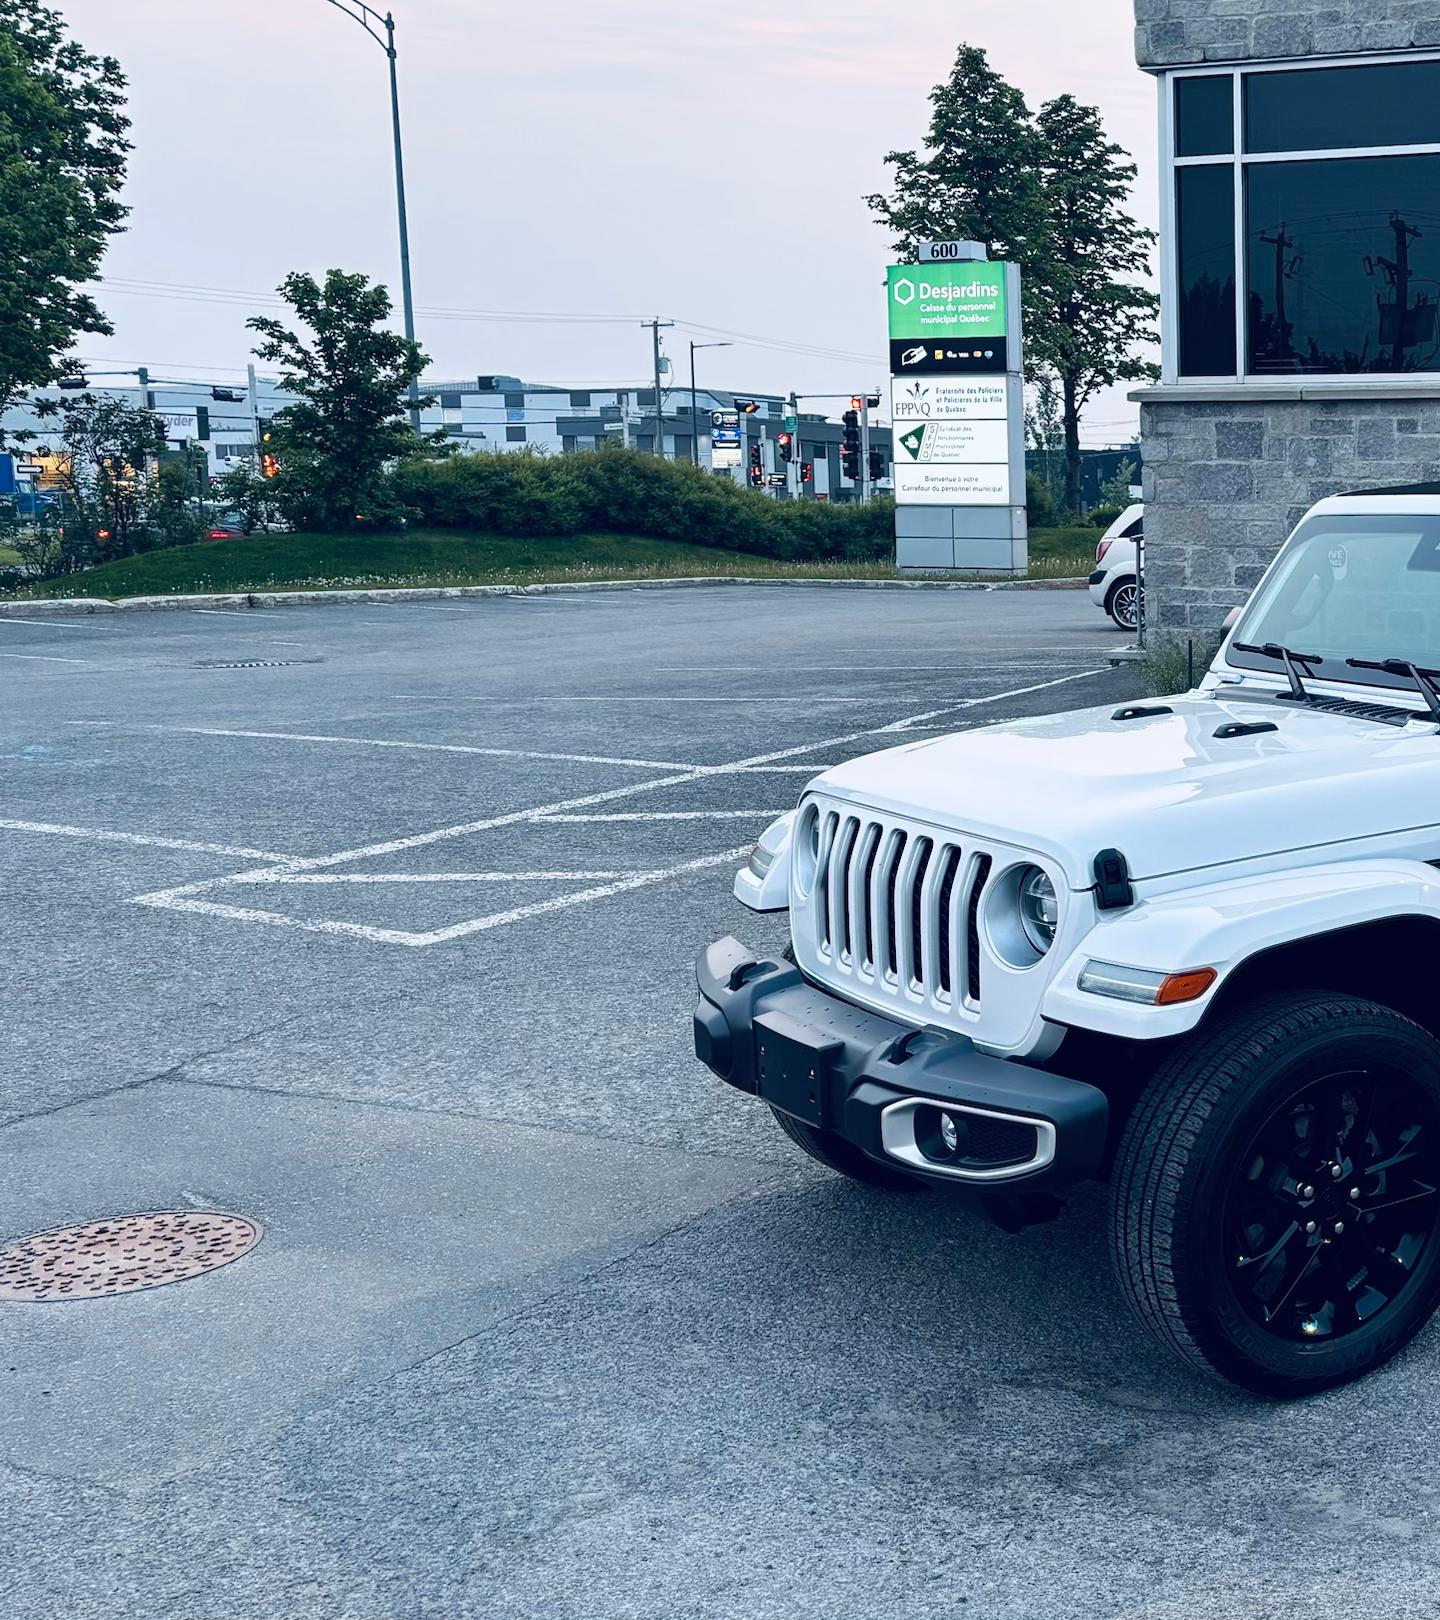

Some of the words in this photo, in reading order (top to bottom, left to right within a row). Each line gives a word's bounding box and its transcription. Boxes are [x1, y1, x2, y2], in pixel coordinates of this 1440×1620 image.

[931, 243, 958, 258] 600
[919, 281, 998, 302] Desjardins
[920, 303, 945, 312] Caisse
[946, 302, 956, 311] du
[957, 301, 996, 312] personnel
[920, 314, 958, 325] municipal
[959, 314, 990, 323] Québec
[978, 386, 1004, 394] Policiers
[895, 402, 931, 417] FPPVQ
[924, 475, 957, 483] Bienvenue
[963, 475, 979, 483] votre
[901, 484, 931, 492] Carrefour
[932, 484, 940, 492] du
[941, 485, 972, 493] personnel
[972, 485, 1003, 493] municipal
